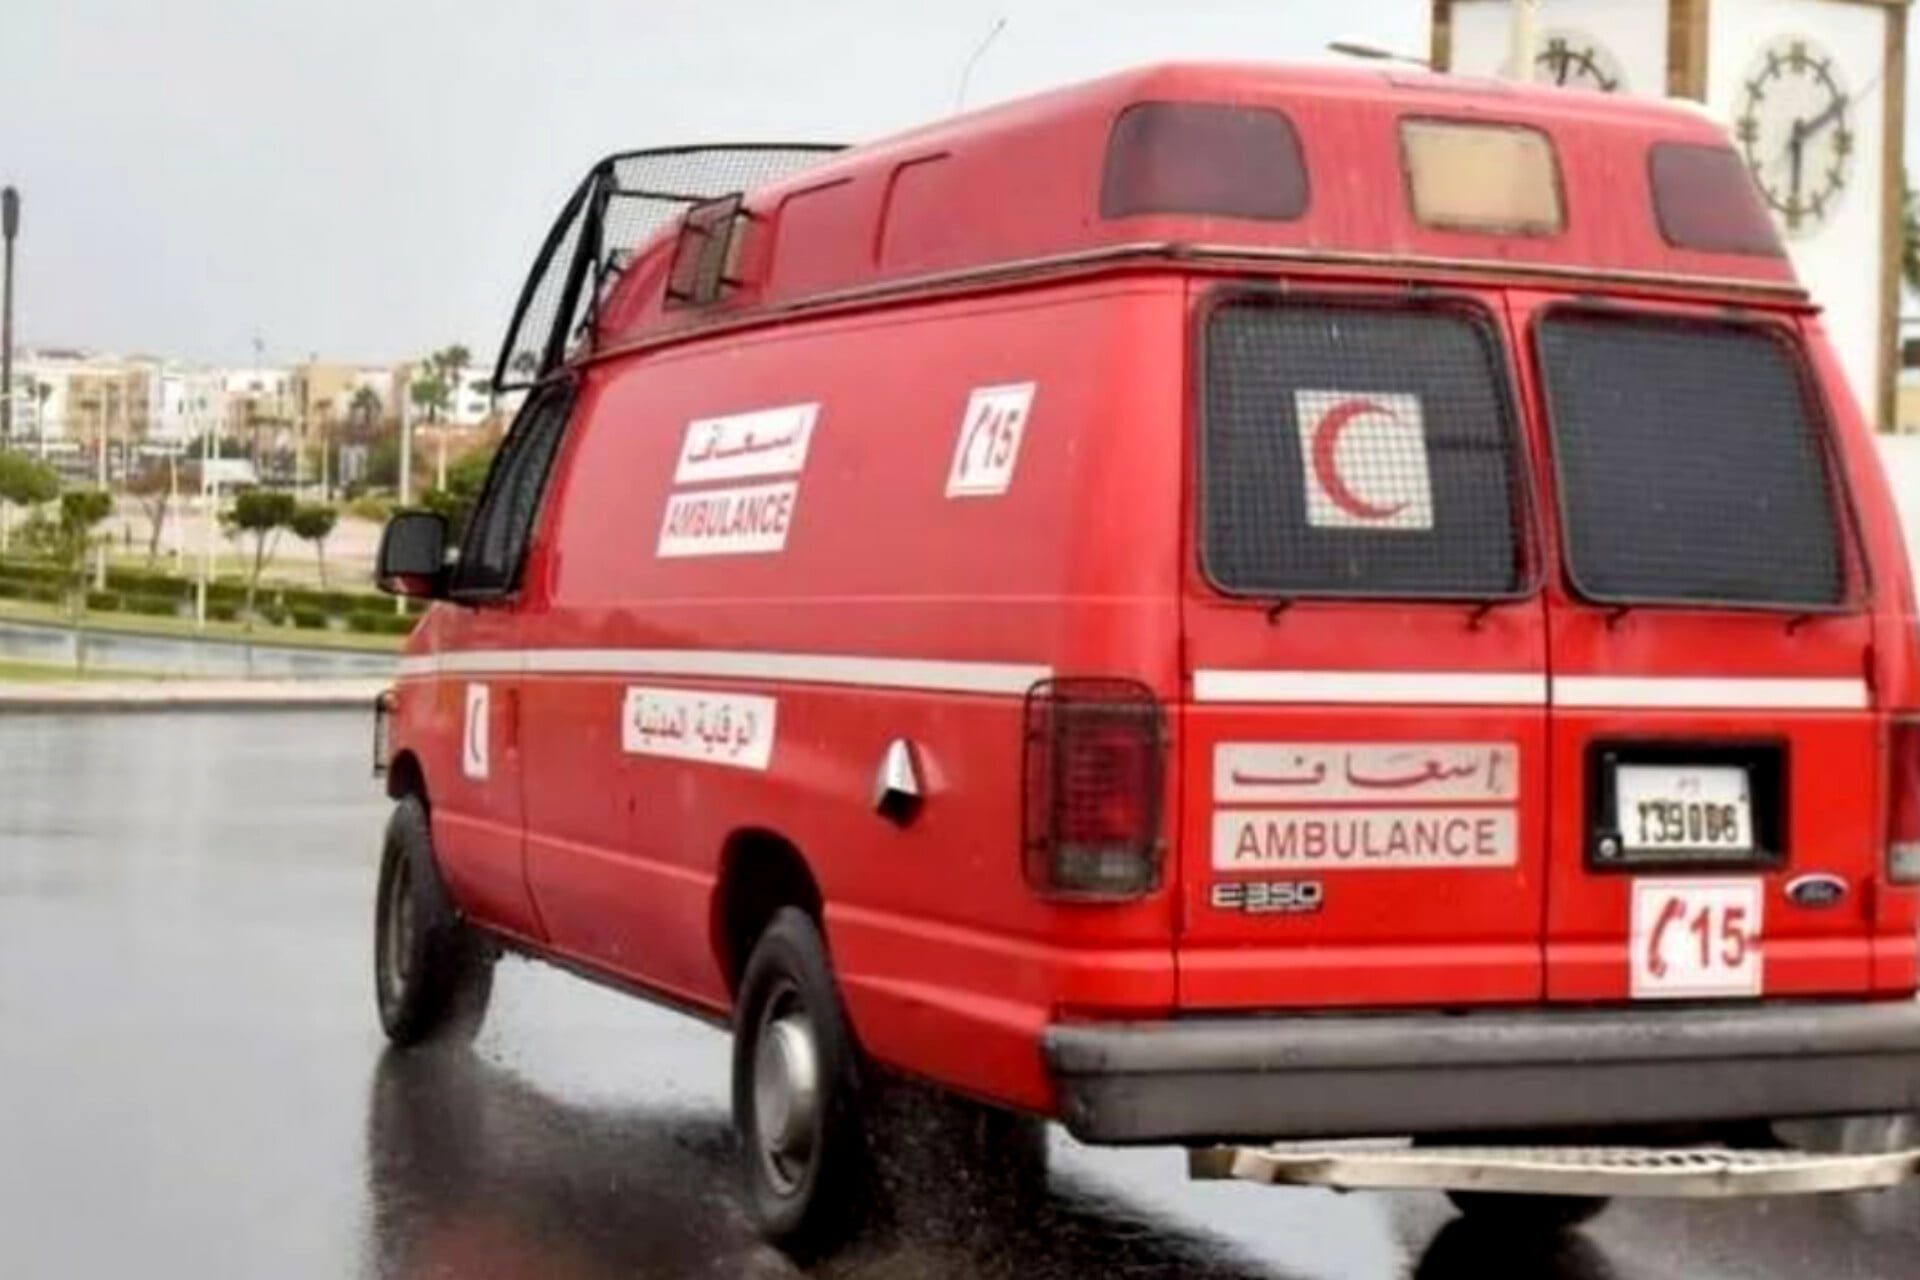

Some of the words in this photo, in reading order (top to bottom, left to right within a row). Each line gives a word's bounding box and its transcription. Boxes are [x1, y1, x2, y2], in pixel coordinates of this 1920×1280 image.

[983, 408, 1021, 469] 15
[667, 493, 792, 539] AMBULANCE
[633, 695, 687, 747] المدنية
[696, 701, 758, 757] الوقاية
[1234, 819, 1497, 859] AMBULANCE
[1689, 906, 1747, 969] 15
